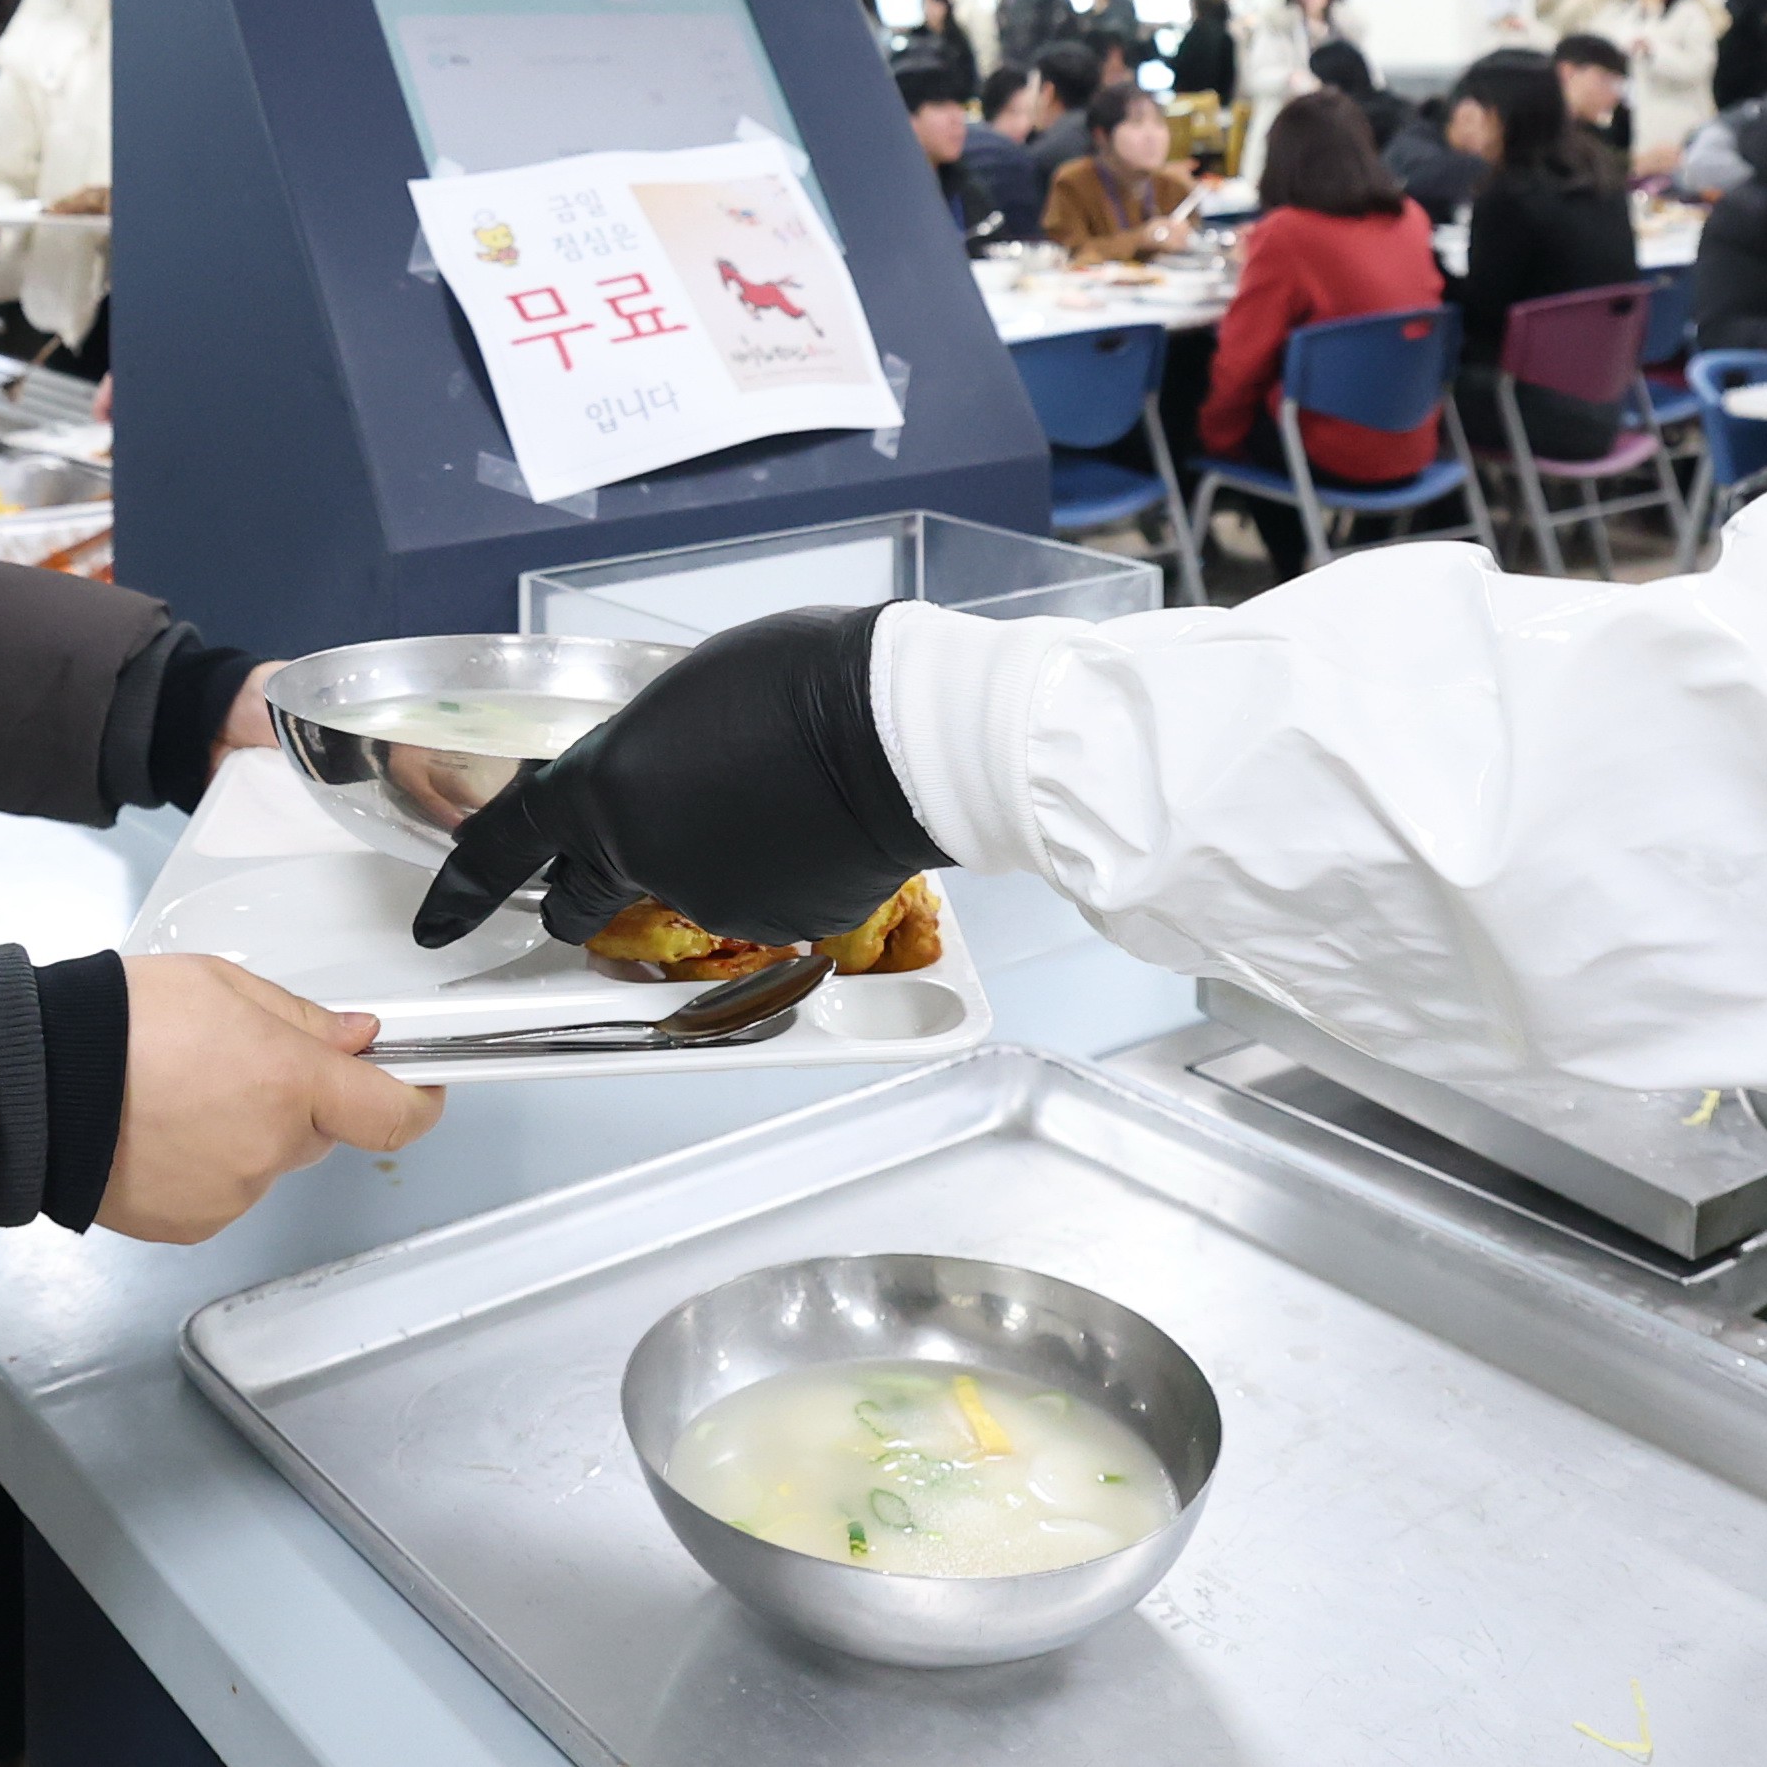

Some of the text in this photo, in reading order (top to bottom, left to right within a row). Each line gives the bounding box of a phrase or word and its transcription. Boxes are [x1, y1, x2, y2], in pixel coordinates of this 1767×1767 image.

[548, 188, 607, 223] 금일
[553, 222, 639, 262] 점심은
[506, 272, 689, 371] 무료
[585, 380, 679, 434] 입니다
